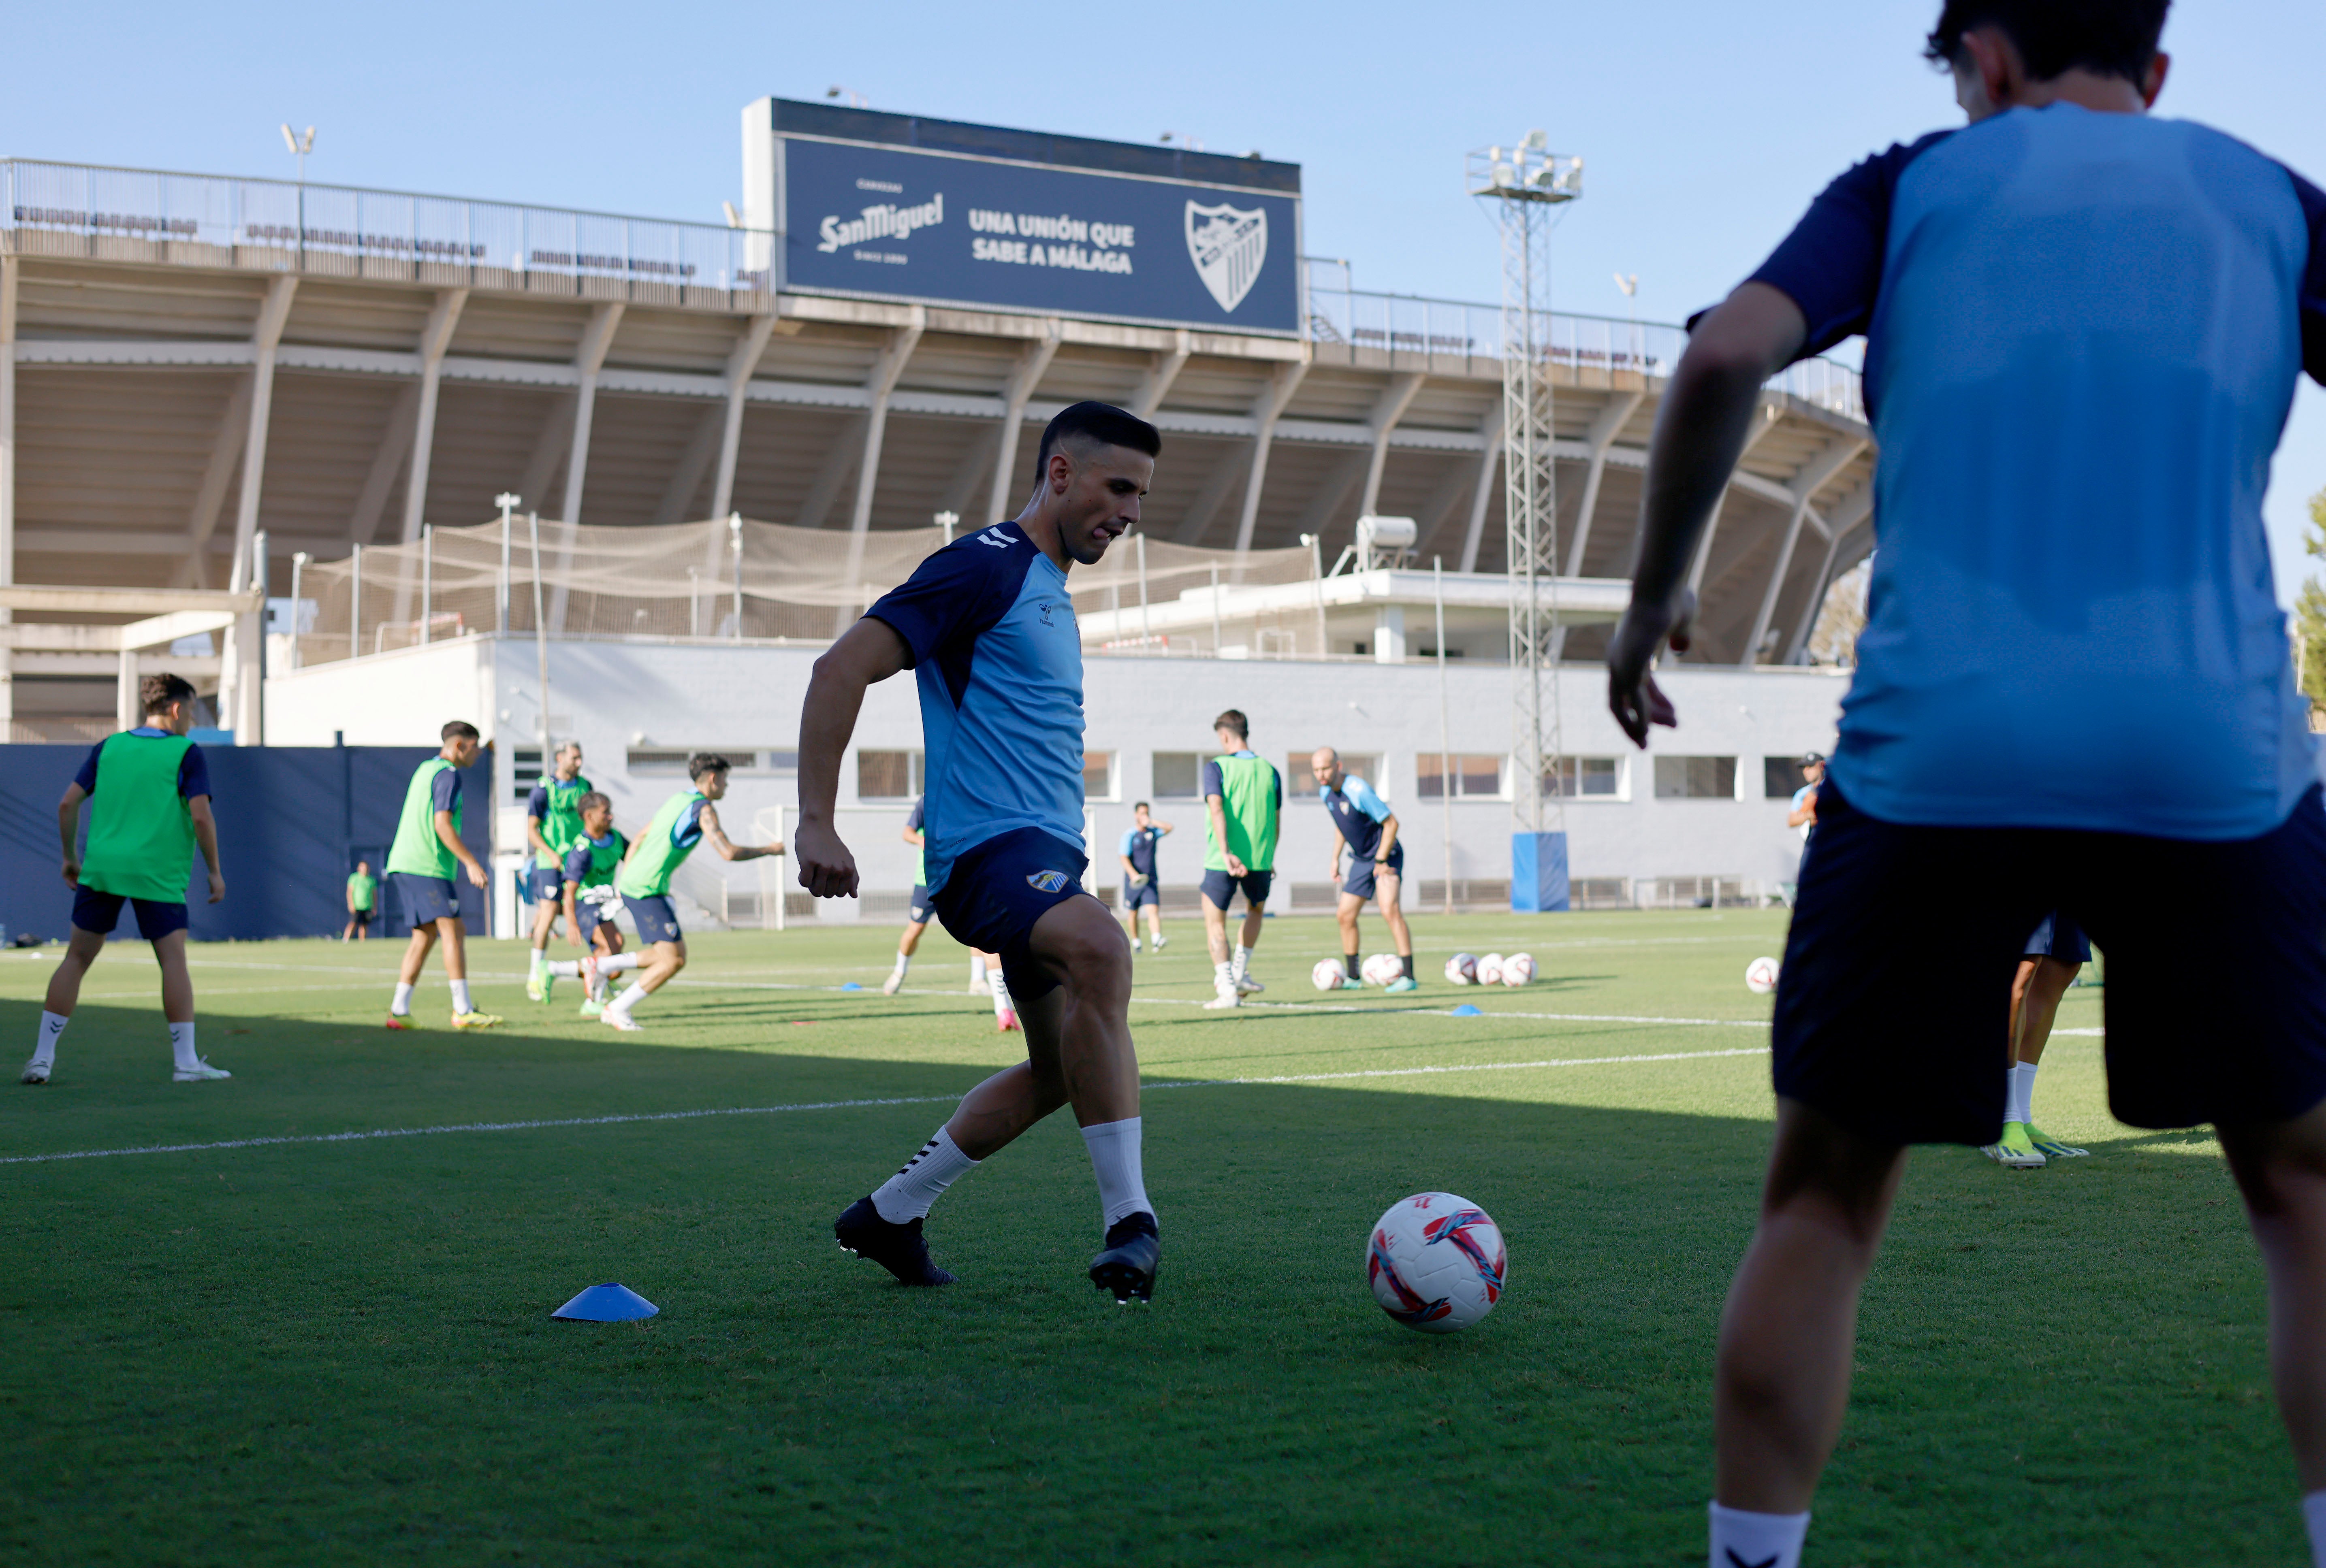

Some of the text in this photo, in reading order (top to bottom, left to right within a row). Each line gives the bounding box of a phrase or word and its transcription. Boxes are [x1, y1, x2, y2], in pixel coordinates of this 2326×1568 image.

[969, 209, 1135, 249] UNA UNIÓN QUE
[973, 238, 1133, 275] SABE A MÁLAGA
